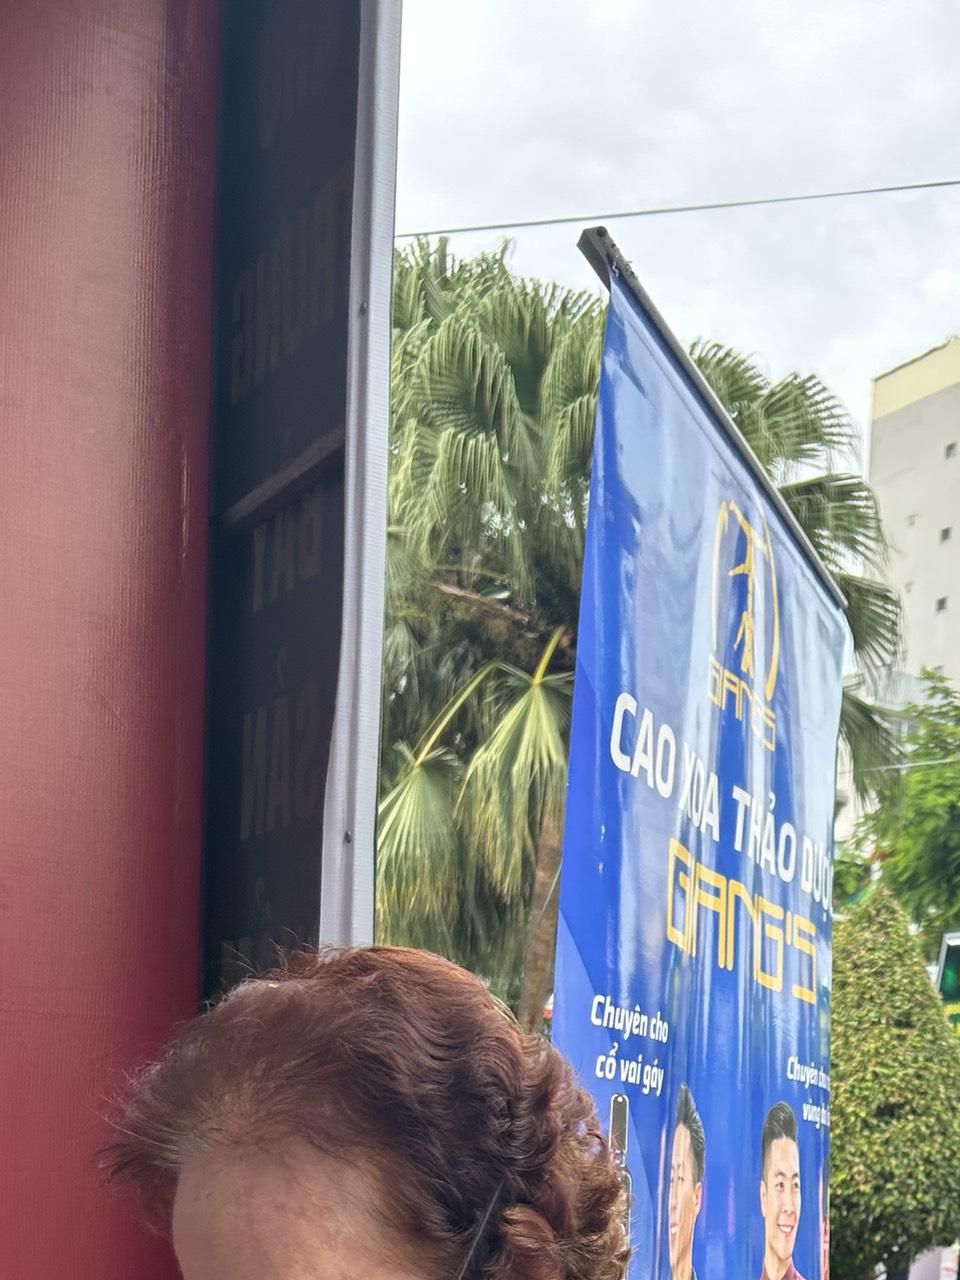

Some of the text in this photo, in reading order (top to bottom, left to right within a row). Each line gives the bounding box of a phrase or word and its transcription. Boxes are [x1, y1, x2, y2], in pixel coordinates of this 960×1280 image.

[610, 692, 676, 799] CAO
[679, 742, 720, 843] XOA
[732, 785, 797, 883] THẢO
[667, 836, 817, 1005] GIANG'S
[591, 995, 669, 1043] Chuyên cho
[595, 1042, 664, 1096] cổ vai gáy
